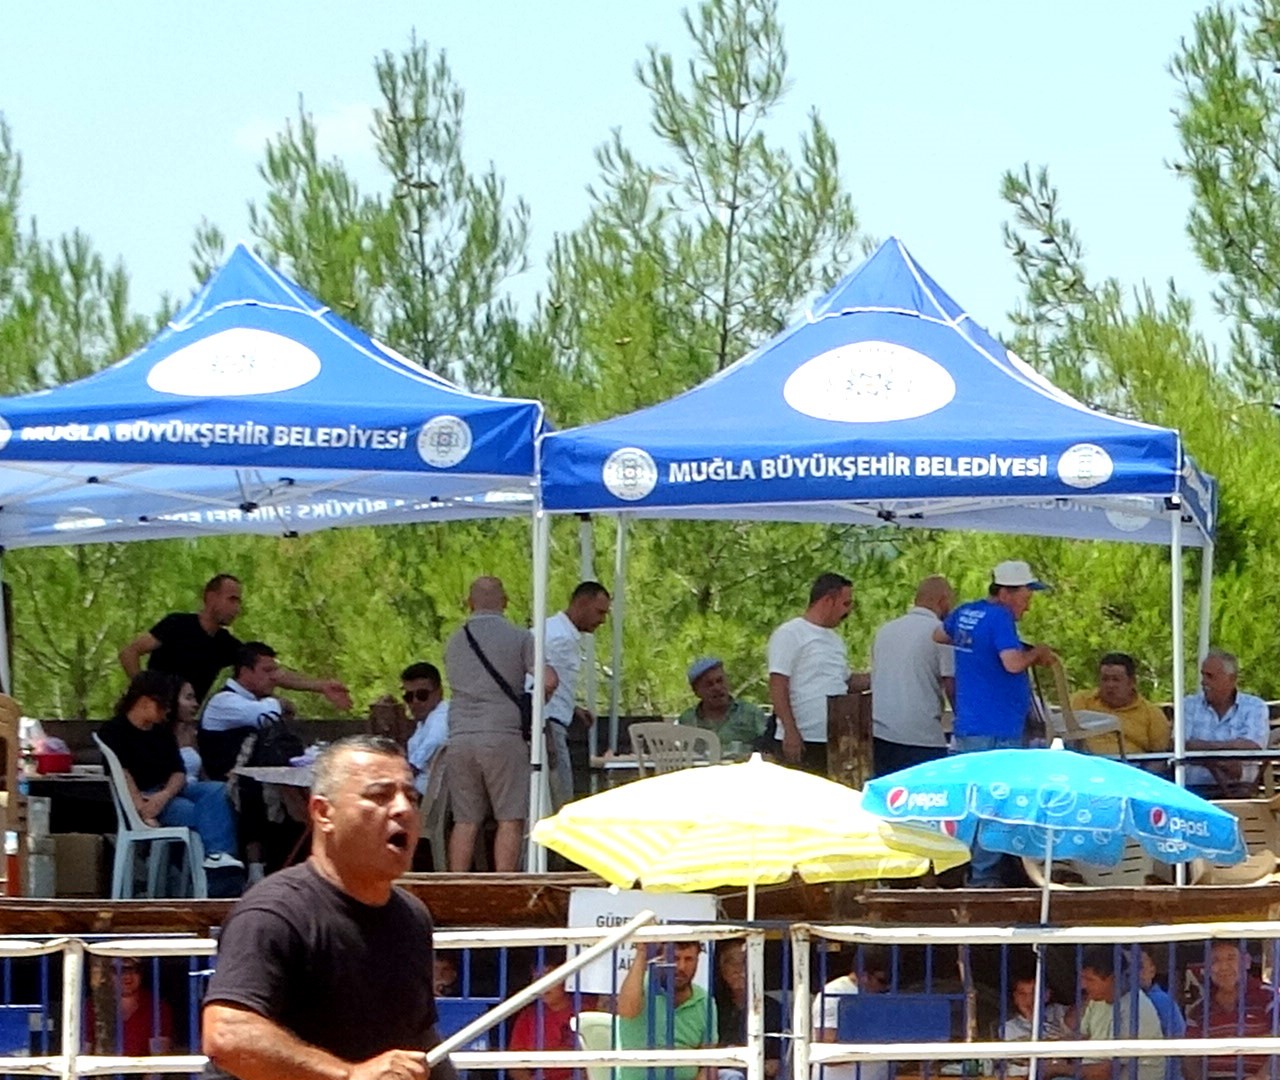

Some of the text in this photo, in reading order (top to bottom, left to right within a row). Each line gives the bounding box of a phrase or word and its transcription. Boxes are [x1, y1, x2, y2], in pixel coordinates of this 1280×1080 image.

[20, 421, 111, 442] MUĞLA
[115, 419, 269, 448] BÜYÜKŞEHİR
[273, 423, 408, 450] BELEDİYESİ
[668, 456, 756, 483] MUĞLA
[761, 452, 910, 482] BÜYÜKŞEHİR
[914, 452, 1048, 478] BELEDİYESİ
[907, 790, 949, 811] pepsi
[1169, 816, 1210, 837] pepsi
